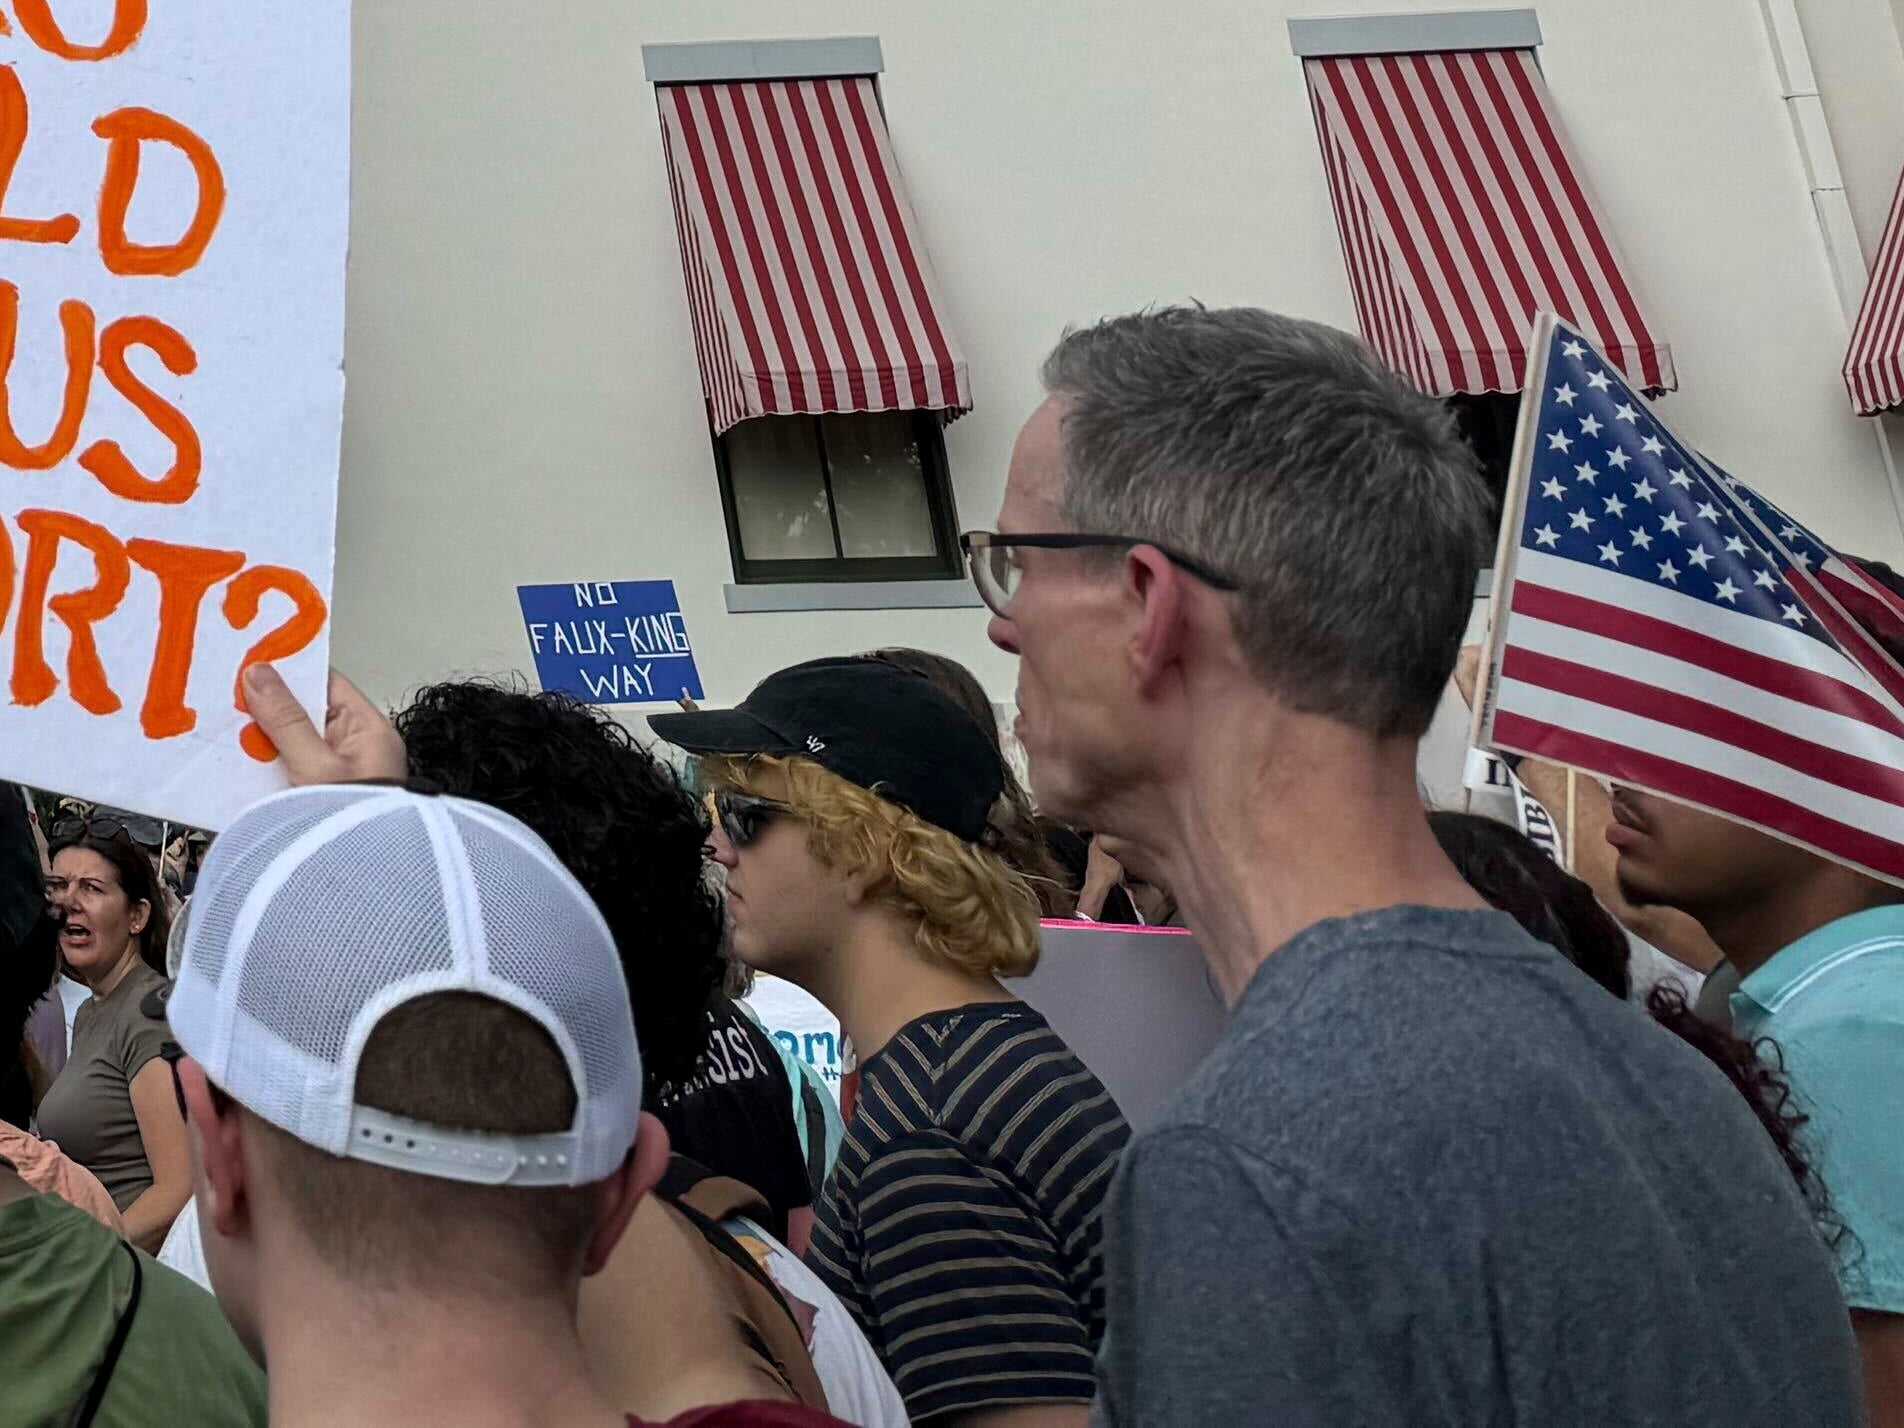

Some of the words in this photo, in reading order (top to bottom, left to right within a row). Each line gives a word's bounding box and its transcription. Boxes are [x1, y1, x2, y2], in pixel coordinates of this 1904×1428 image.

[573, 582, 618, 607] NO
[529, 611, 691, 656] FAUX-KING
[580, 662, 653, 699] WAY
